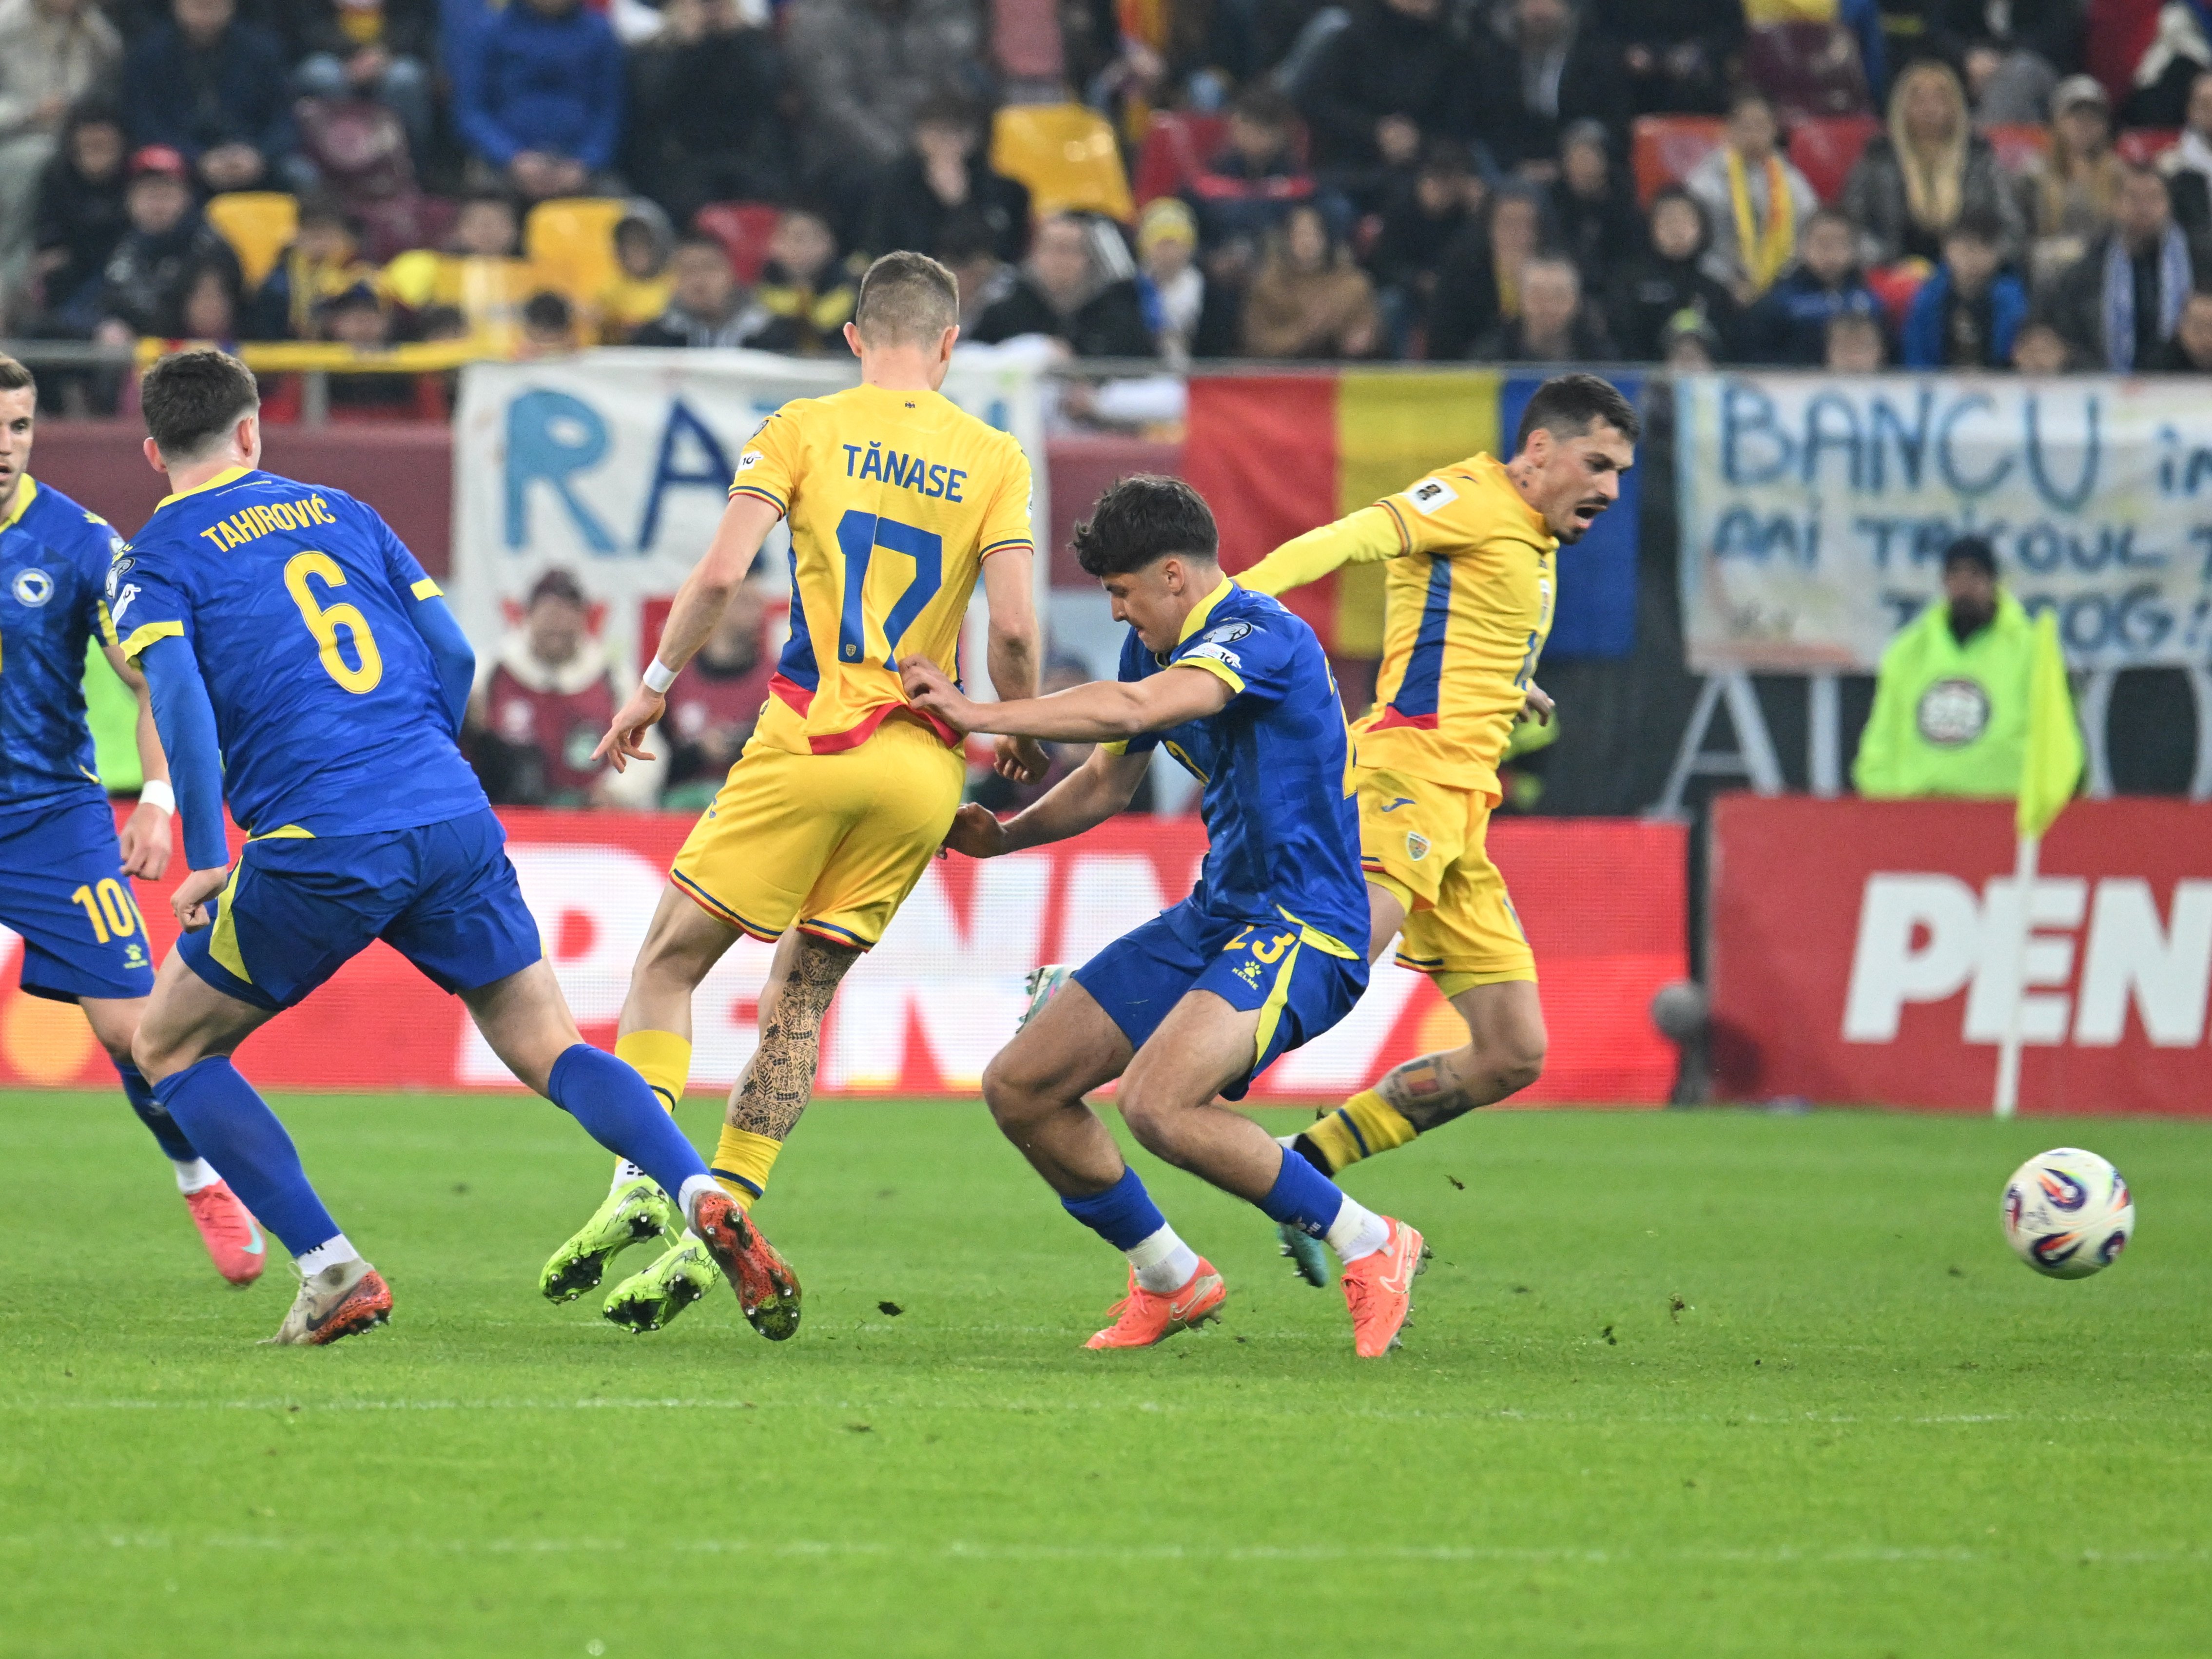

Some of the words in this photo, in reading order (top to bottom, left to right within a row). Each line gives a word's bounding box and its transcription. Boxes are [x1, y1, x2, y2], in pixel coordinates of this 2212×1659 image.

[843, 441, 968, 503] TĂNASE
[1721, 383, 2101, 513] BANCU
[200, 494, 336, 552] TAHIROVIĆ
[284, 551, 383, 694] 6
[836, 510, 942, 672] 17
[72, 878, 135, 944] 10
[1222, 925, 1297, 964] 23
[1232, 967, 1259, 990] KELME
